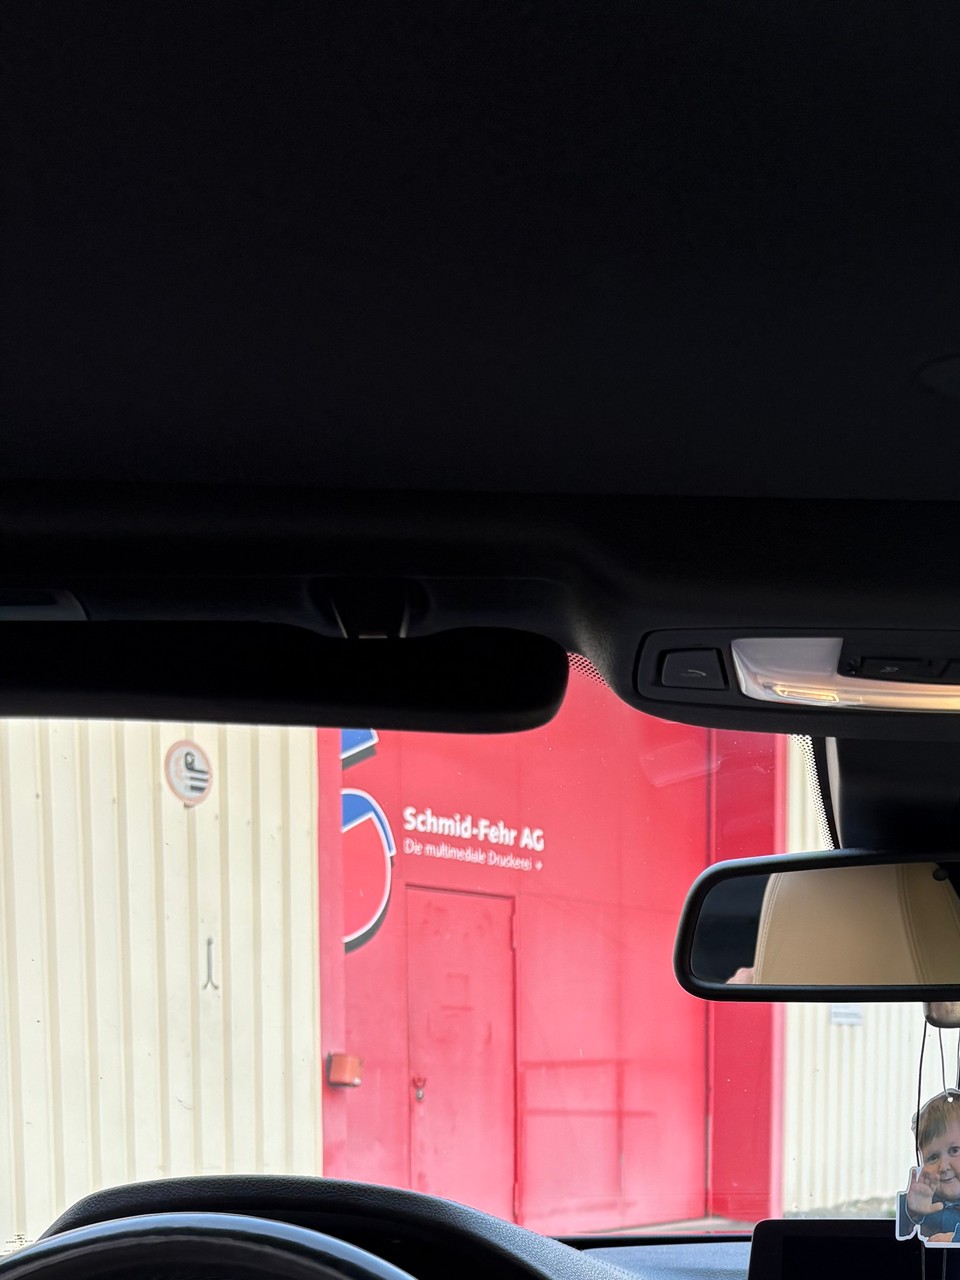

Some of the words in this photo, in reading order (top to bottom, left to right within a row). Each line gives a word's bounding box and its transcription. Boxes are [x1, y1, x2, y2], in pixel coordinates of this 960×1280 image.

[403, 806, 517, 846] Schmid-Fehr
[519, 826, 544, 852] AG
[403, 837, 423, 855] Die
[424, 842, 486, 865] multimediale
[488, 850, 532, 871] Druckerei
